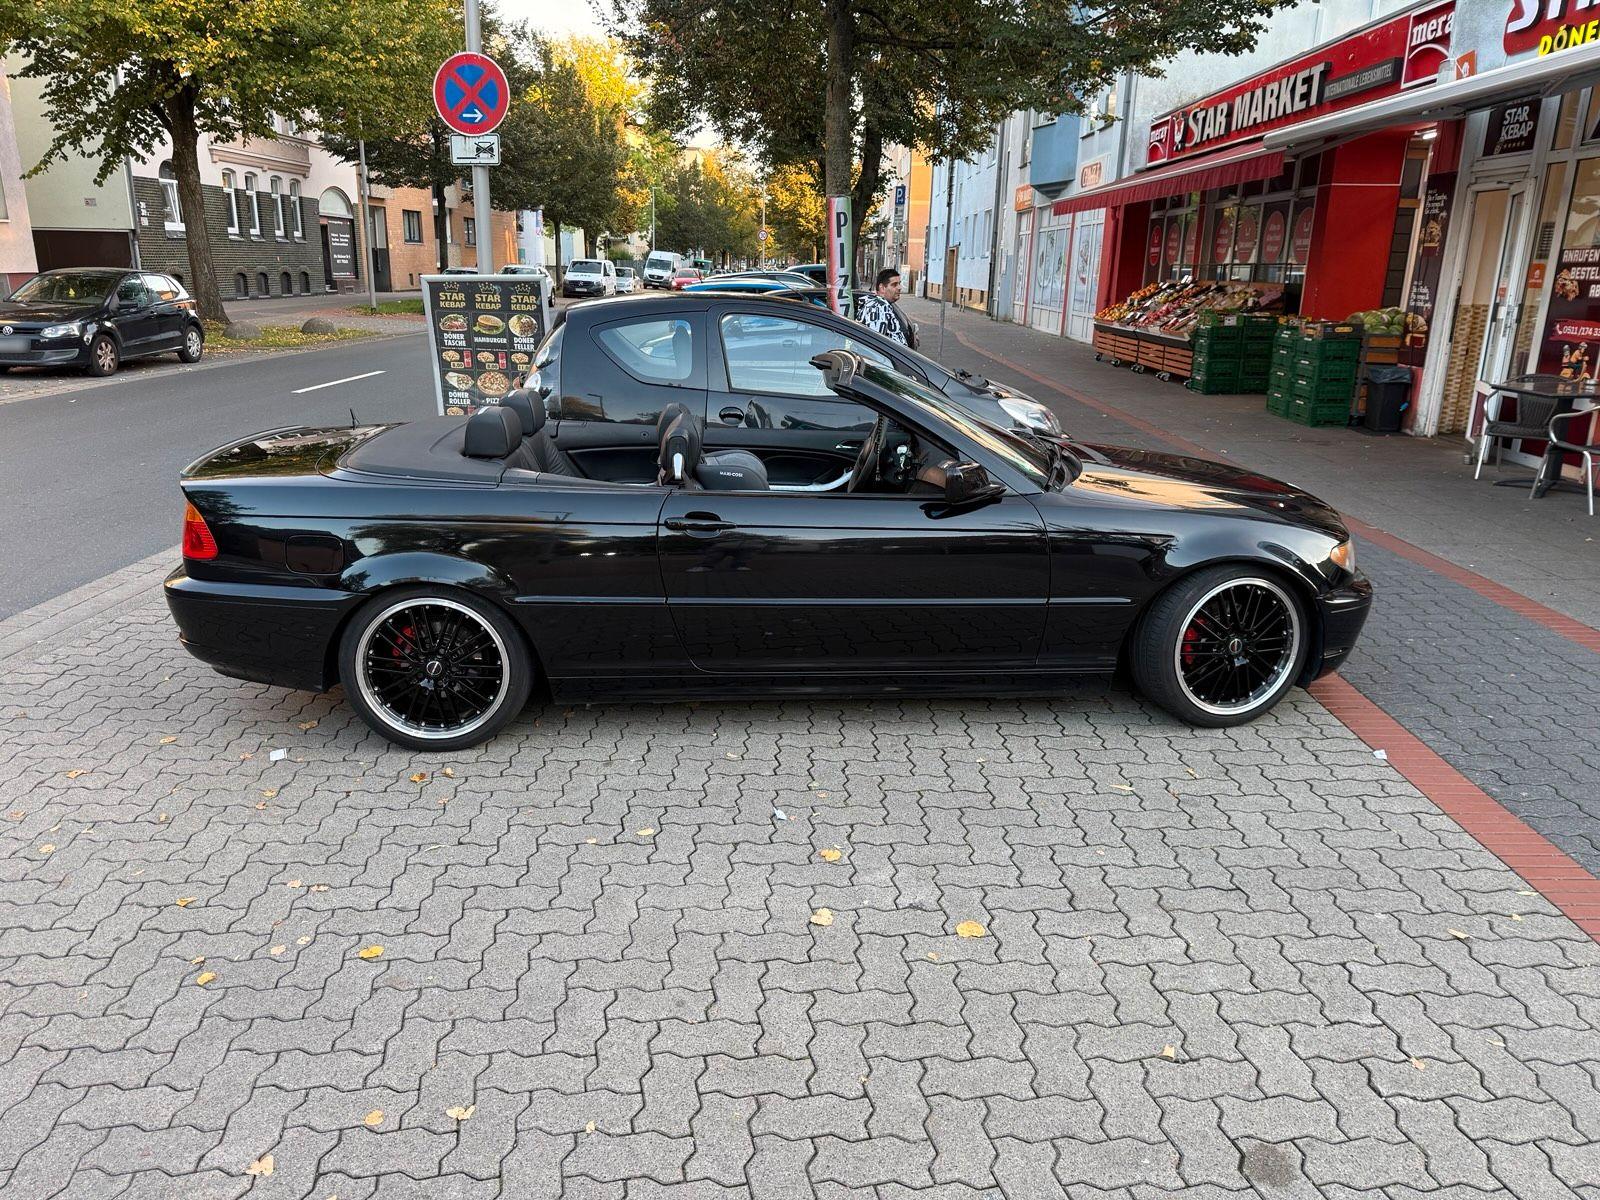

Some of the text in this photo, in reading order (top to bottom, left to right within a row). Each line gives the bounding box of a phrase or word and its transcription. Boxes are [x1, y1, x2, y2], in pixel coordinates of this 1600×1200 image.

[1538, 20, 1600, 57] DÖNE
[1325, 63, 1392, 99] INTERNATIONALE LEBENSMITTEL
[1185, 63, 1326, 147] STAR MARKET
[1503, 105, 1530, 125] STAR
[1500, 121, 1534, 140] KEBAP
[1563, 249, 1600, 262] ANRUFEN
[1570, 267, 1600, 280] BESTEL
[439, 292, 465, 301] STAR
[475, 293, 500, 302] STAR
[510, 295, 536, 304] STAR
[475, 302, 502, 310] KEBAP
[444, 339, 466, 347] TASCHE
